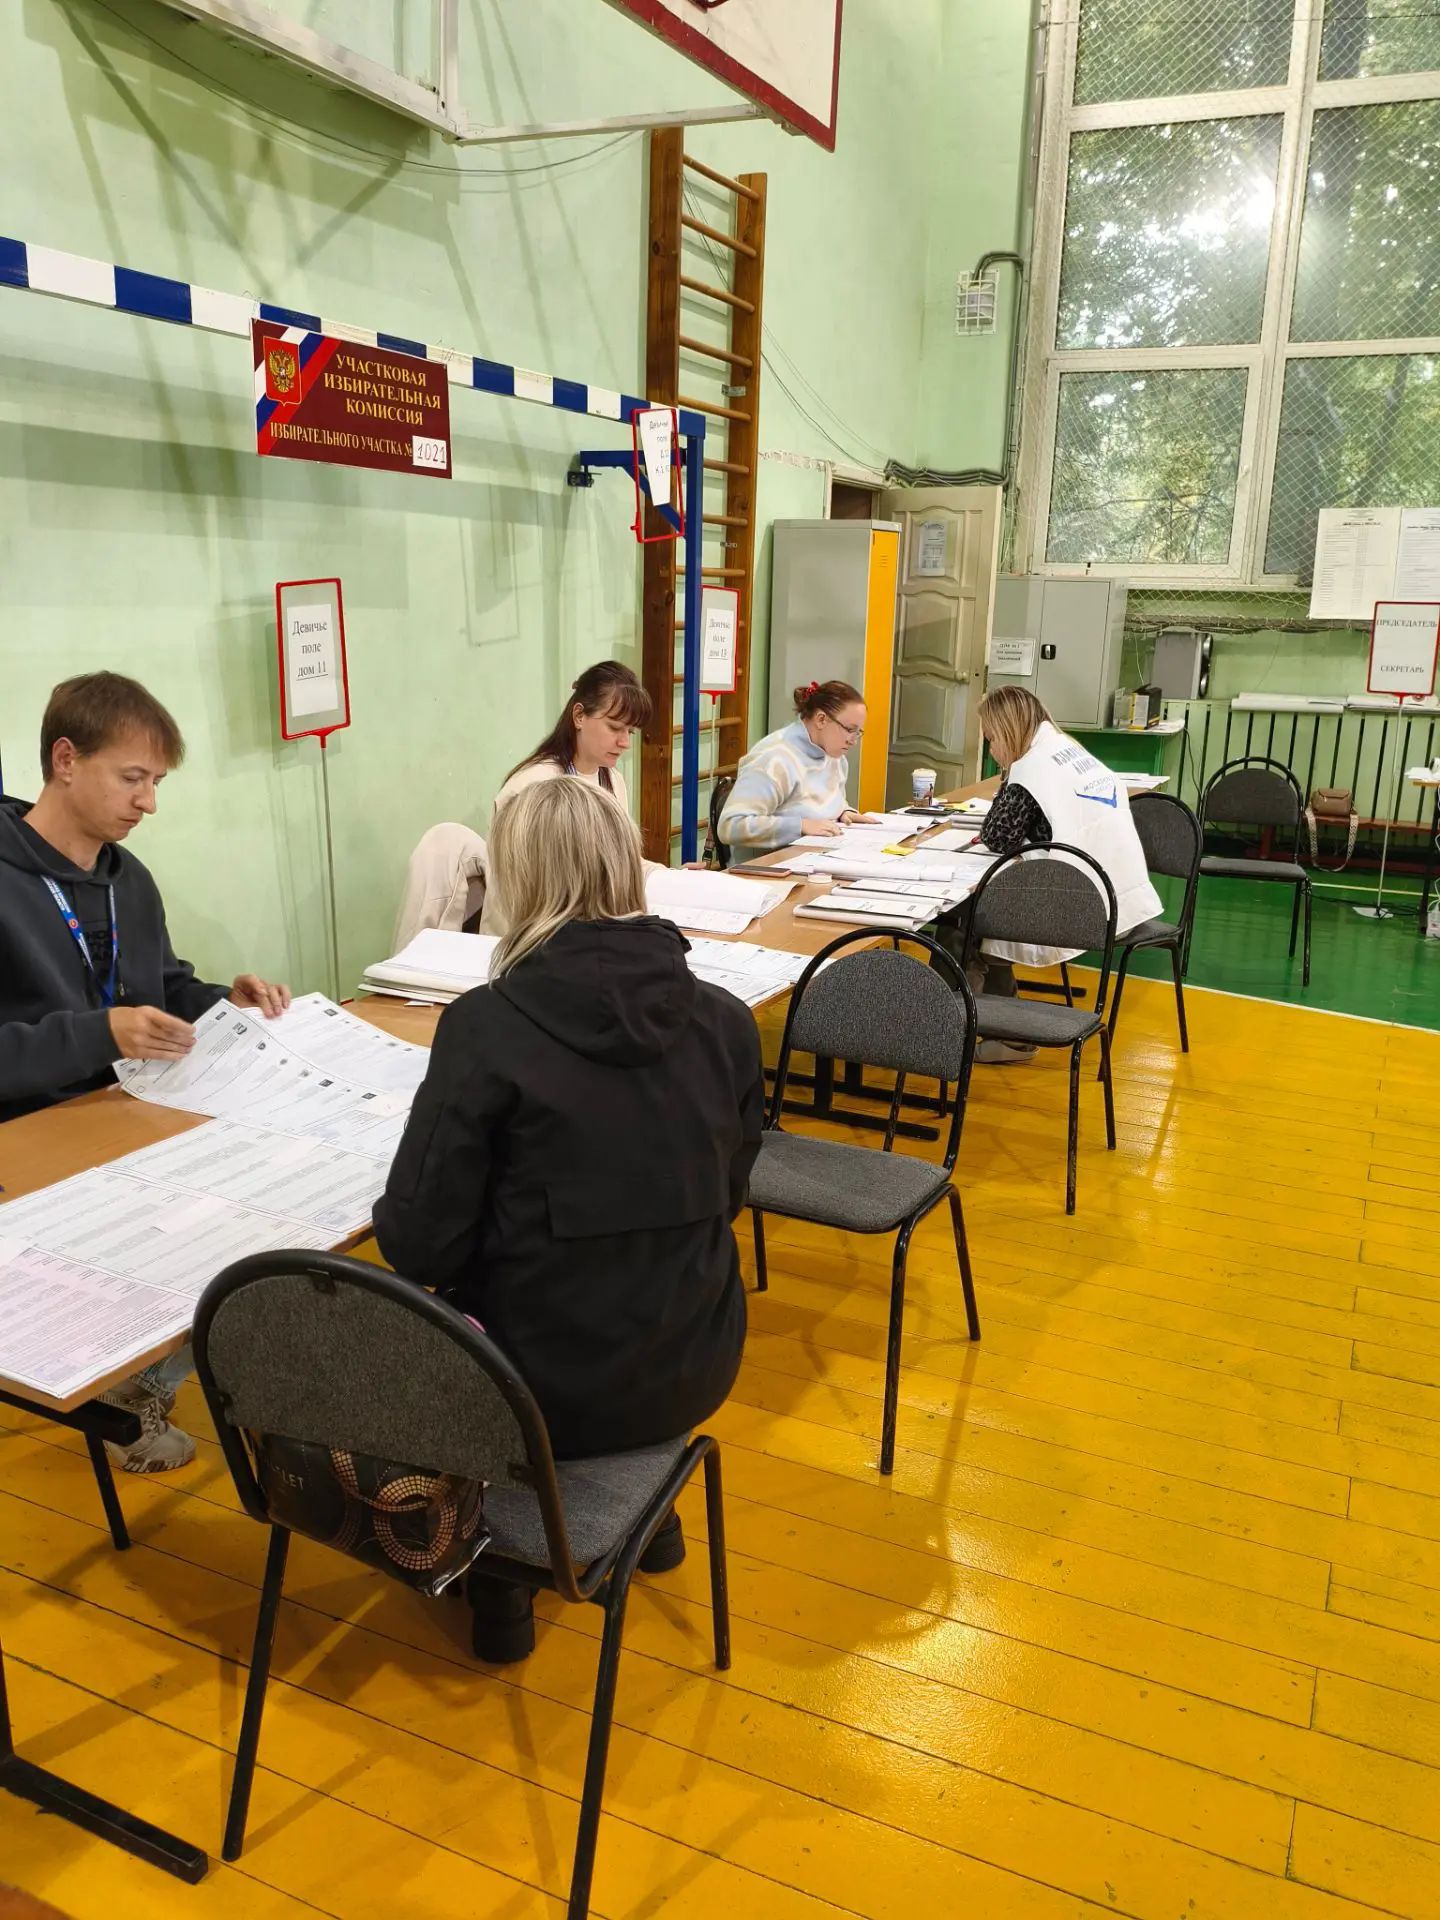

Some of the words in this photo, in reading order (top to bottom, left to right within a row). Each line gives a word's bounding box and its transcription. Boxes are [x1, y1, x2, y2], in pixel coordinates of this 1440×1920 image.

[336, 354, 427, 387] УЧАСТКОВАЯ
[324, 373, 441, 409] ИЗБИРАТЕЛЬНАЯ
[346, 398, 424, 426] КОМИССИЯ
[270, 422, 359, 449] ИЗБИРАТЕЛЬНОГО
[361, 436, 403, 456] УЧАСТКА
[417, 443, 446, 464] 1021
[292, 620, 327, 635] Девичье
[1376, 620, 1437, 628] ПРЕДСЕДАТЕЛЬ
[302, 643, 321, 654] поле
[298, 666, 315, 677] дом
[318, 661, 326, 673] 11
[1380, 665, 1424, 674] СЕКРЕТАРЬ
